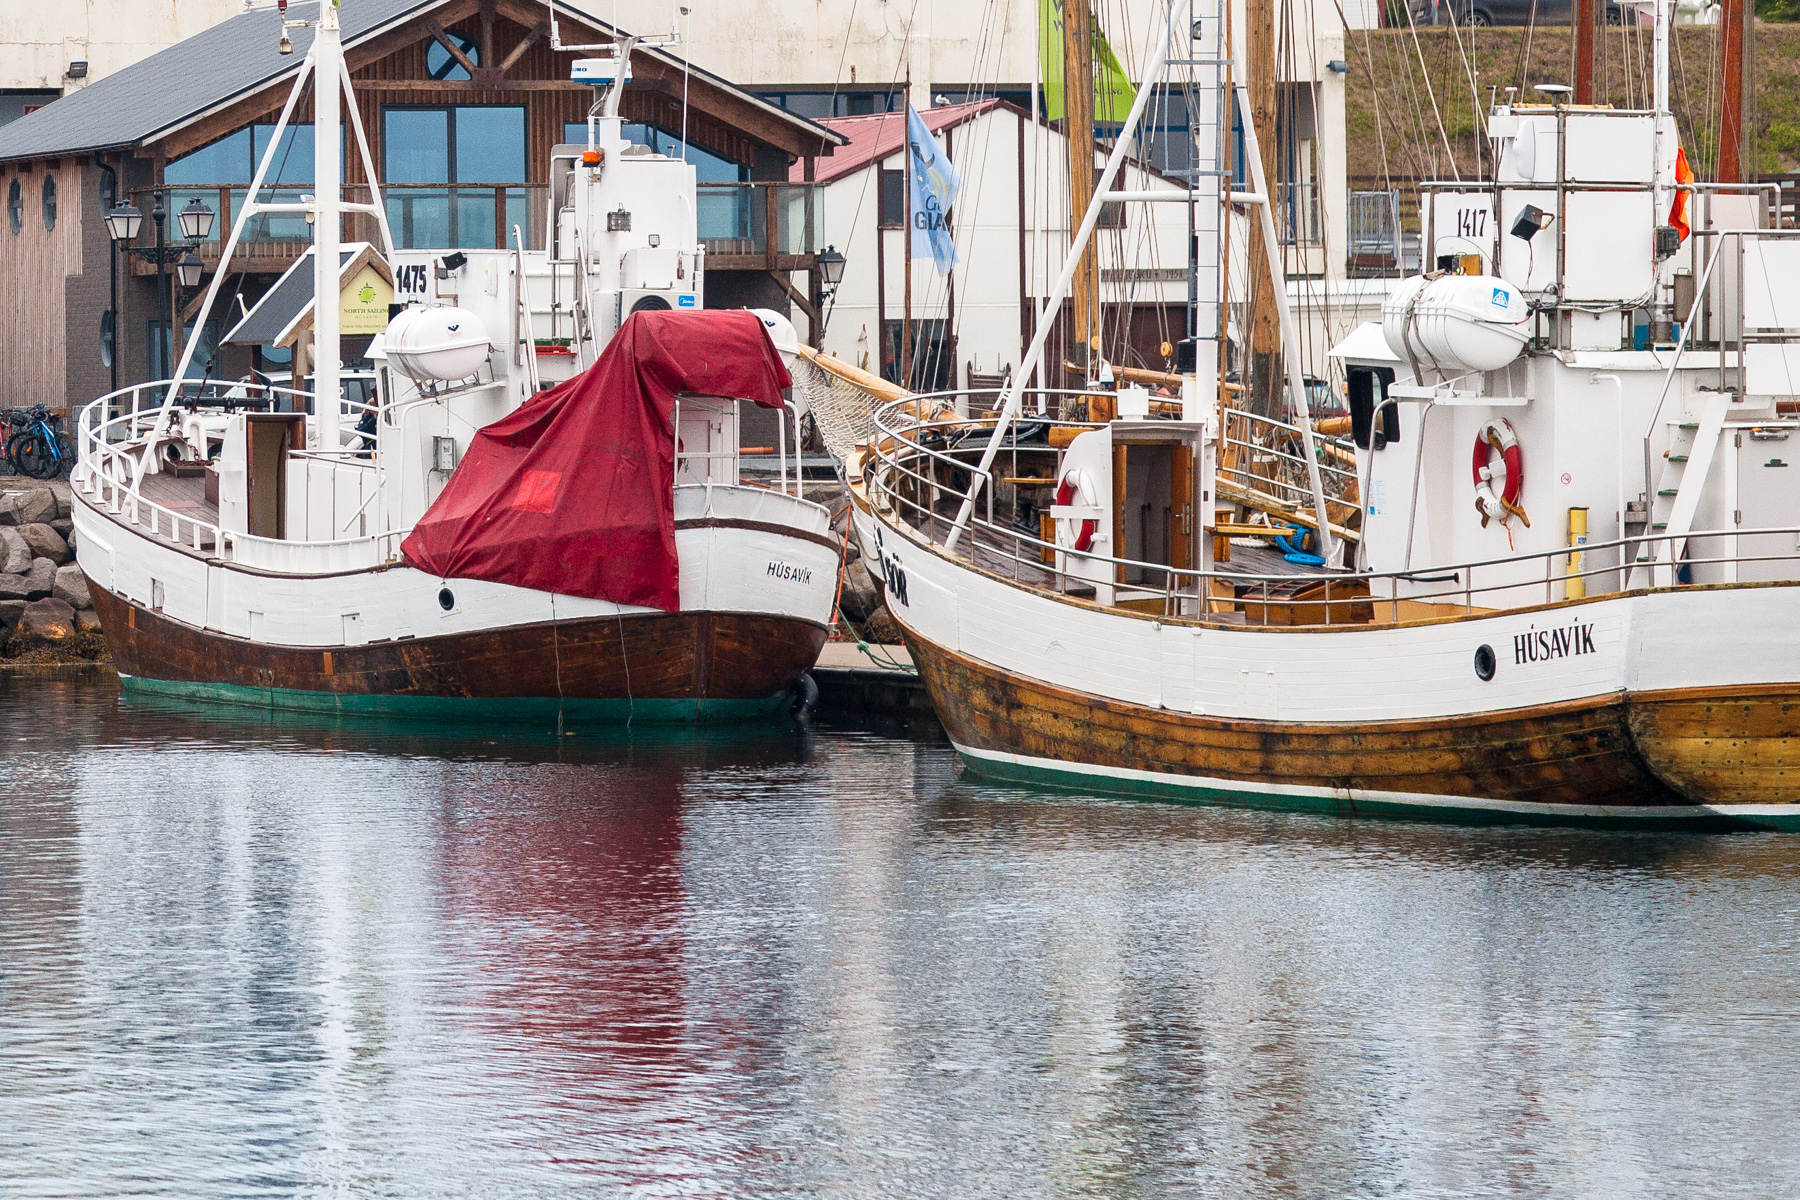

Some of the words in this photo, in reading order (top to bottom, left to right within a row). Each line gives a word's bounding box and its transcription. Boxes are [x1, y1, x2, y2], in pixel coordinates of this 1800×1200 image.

[1457, 208, 1488, 237] 1417
[396, 264, 428, 293] 1475
[767, 561, 812, 585] HÚSAVÍK
[1513, 616, 1596, 665] HÚSAVÍK
